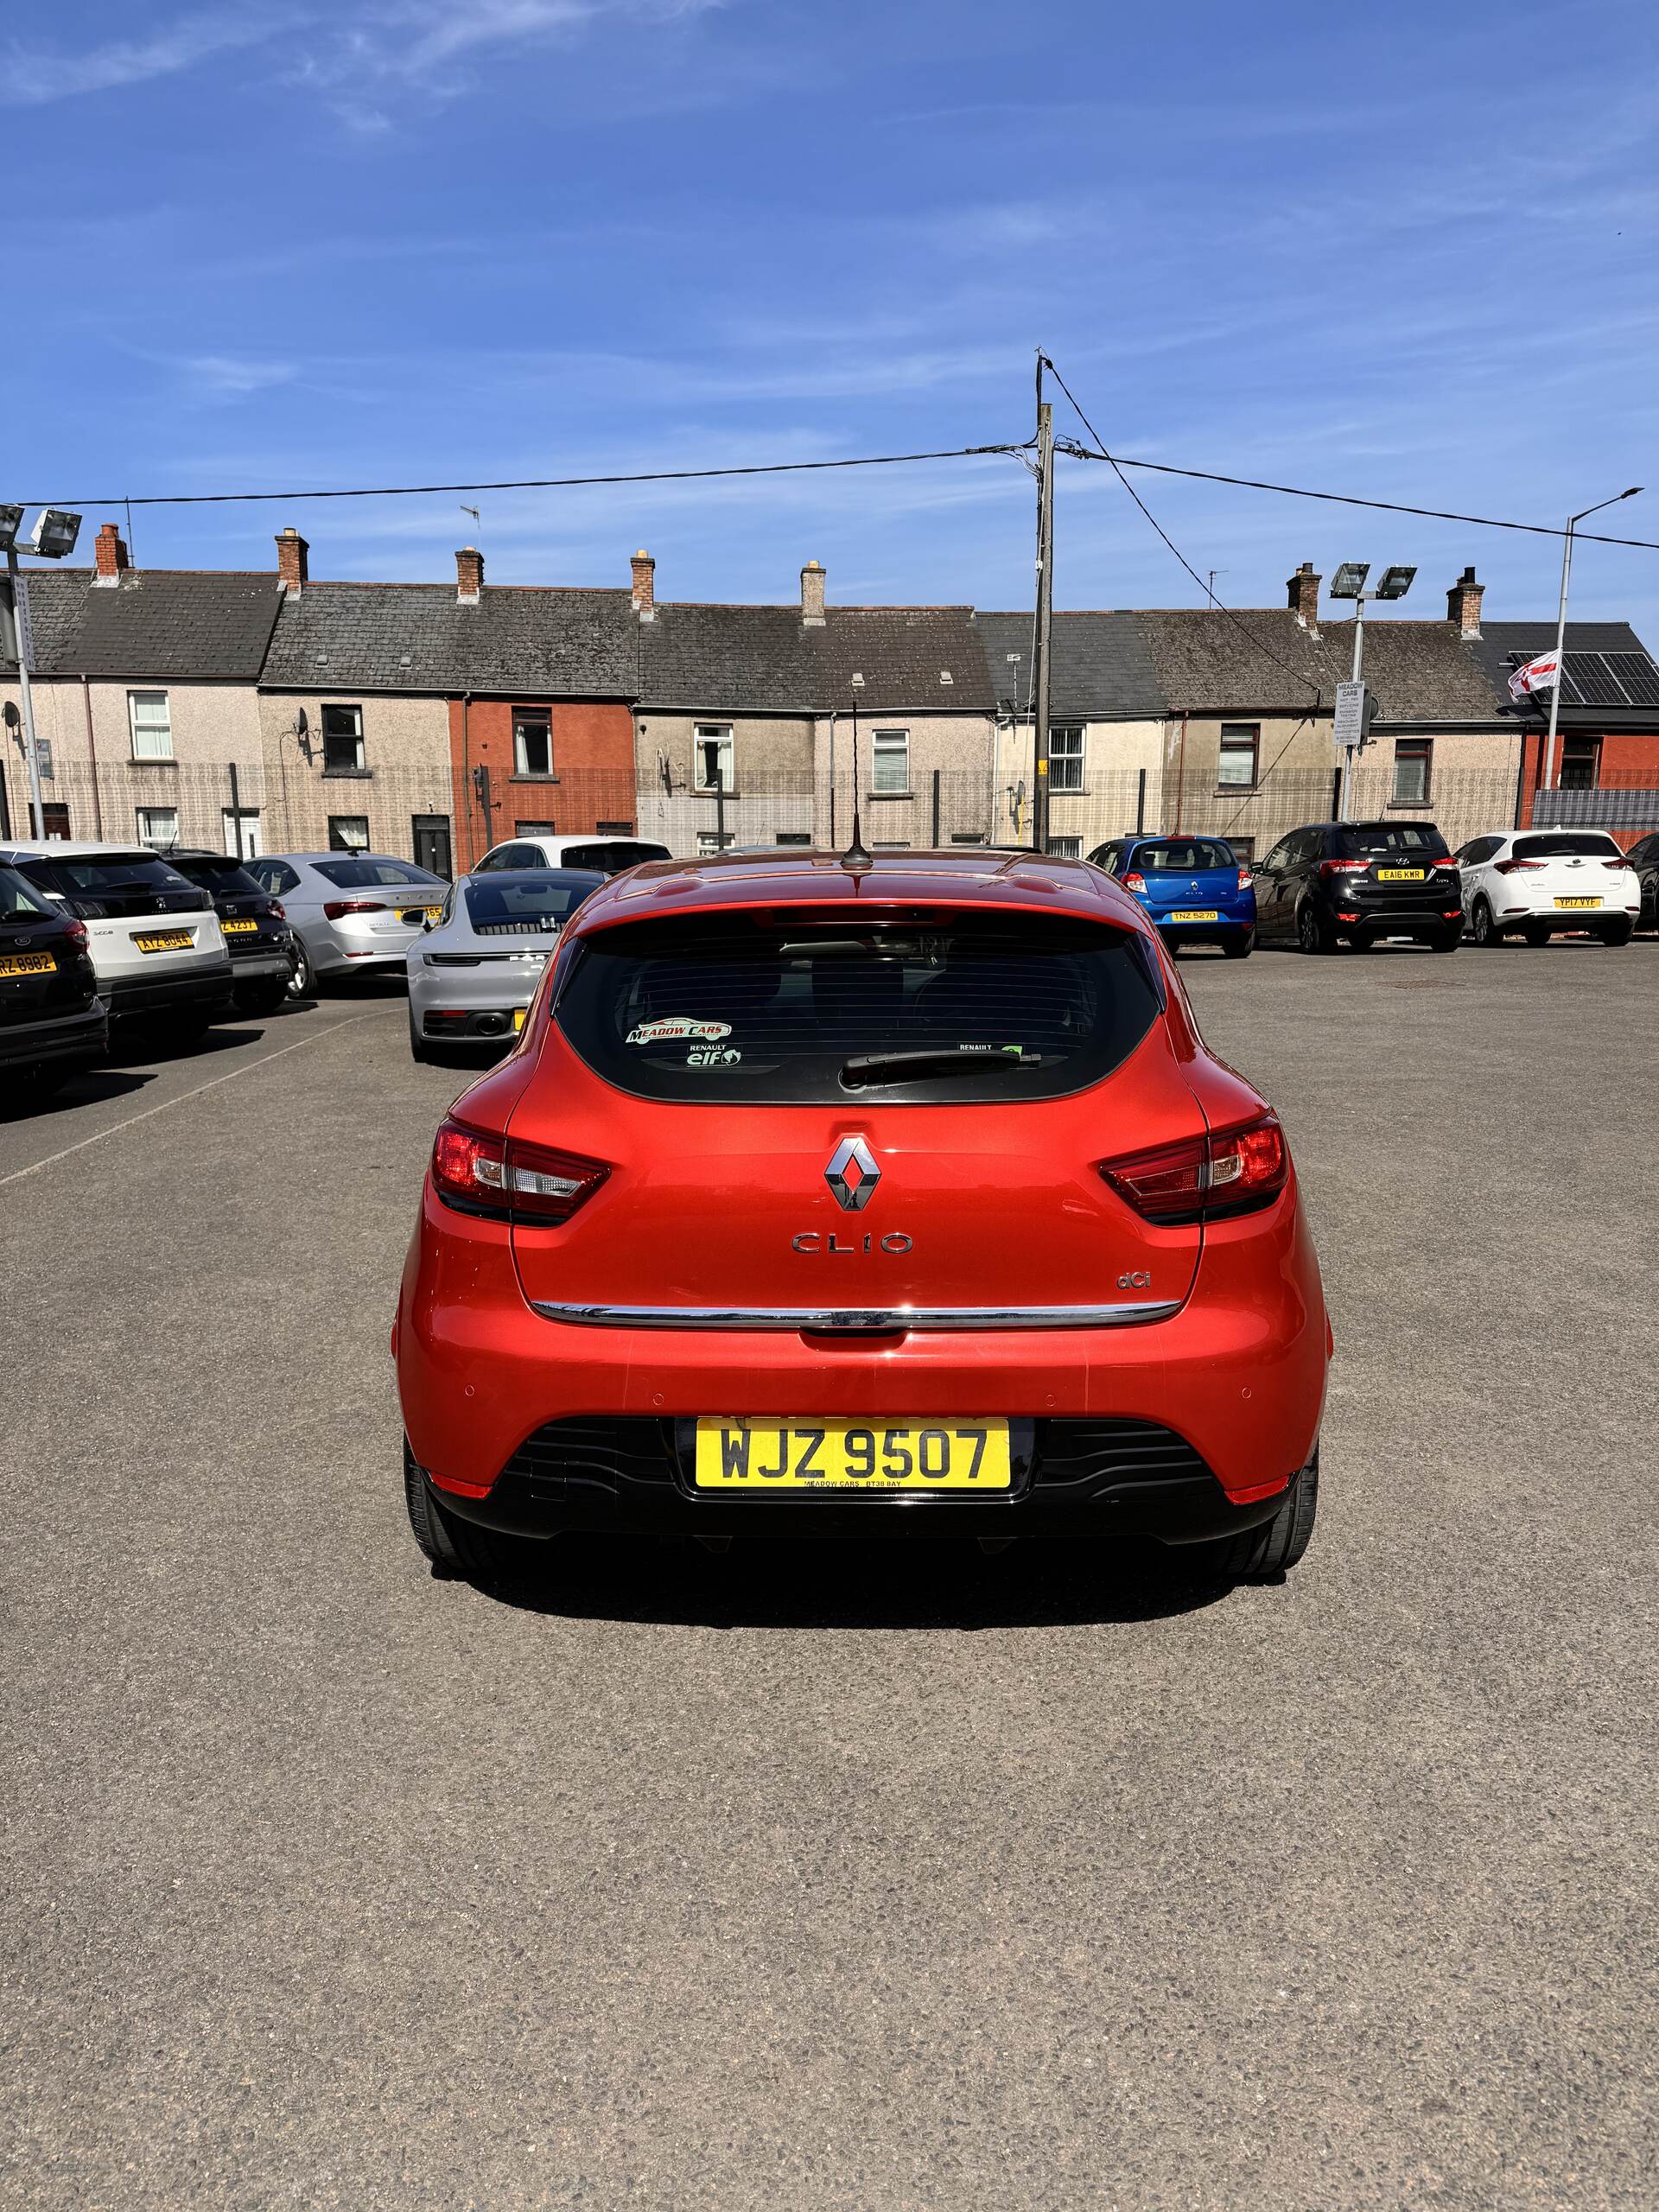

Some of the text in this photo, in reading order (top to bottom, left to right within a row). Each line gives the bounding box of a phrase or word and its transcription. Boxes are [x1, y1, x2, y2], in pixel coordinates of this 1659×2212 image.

[1338, 682, 1363, 690] MEADOW
[142, 934, 188, 949] AYZ 8044
[16, 956, 50, 971] 8982
[630, 1027, 686, 1041] MEADOW
[688, 1026, 722, 1035] CARS
[686, 1051, 721, 1065] elf
[791, 1232, 913, 1254] CLIO
[1117, 1271, 1151, 1289] dCi
[721, 1428, 988, 1478] WJZ 9507
